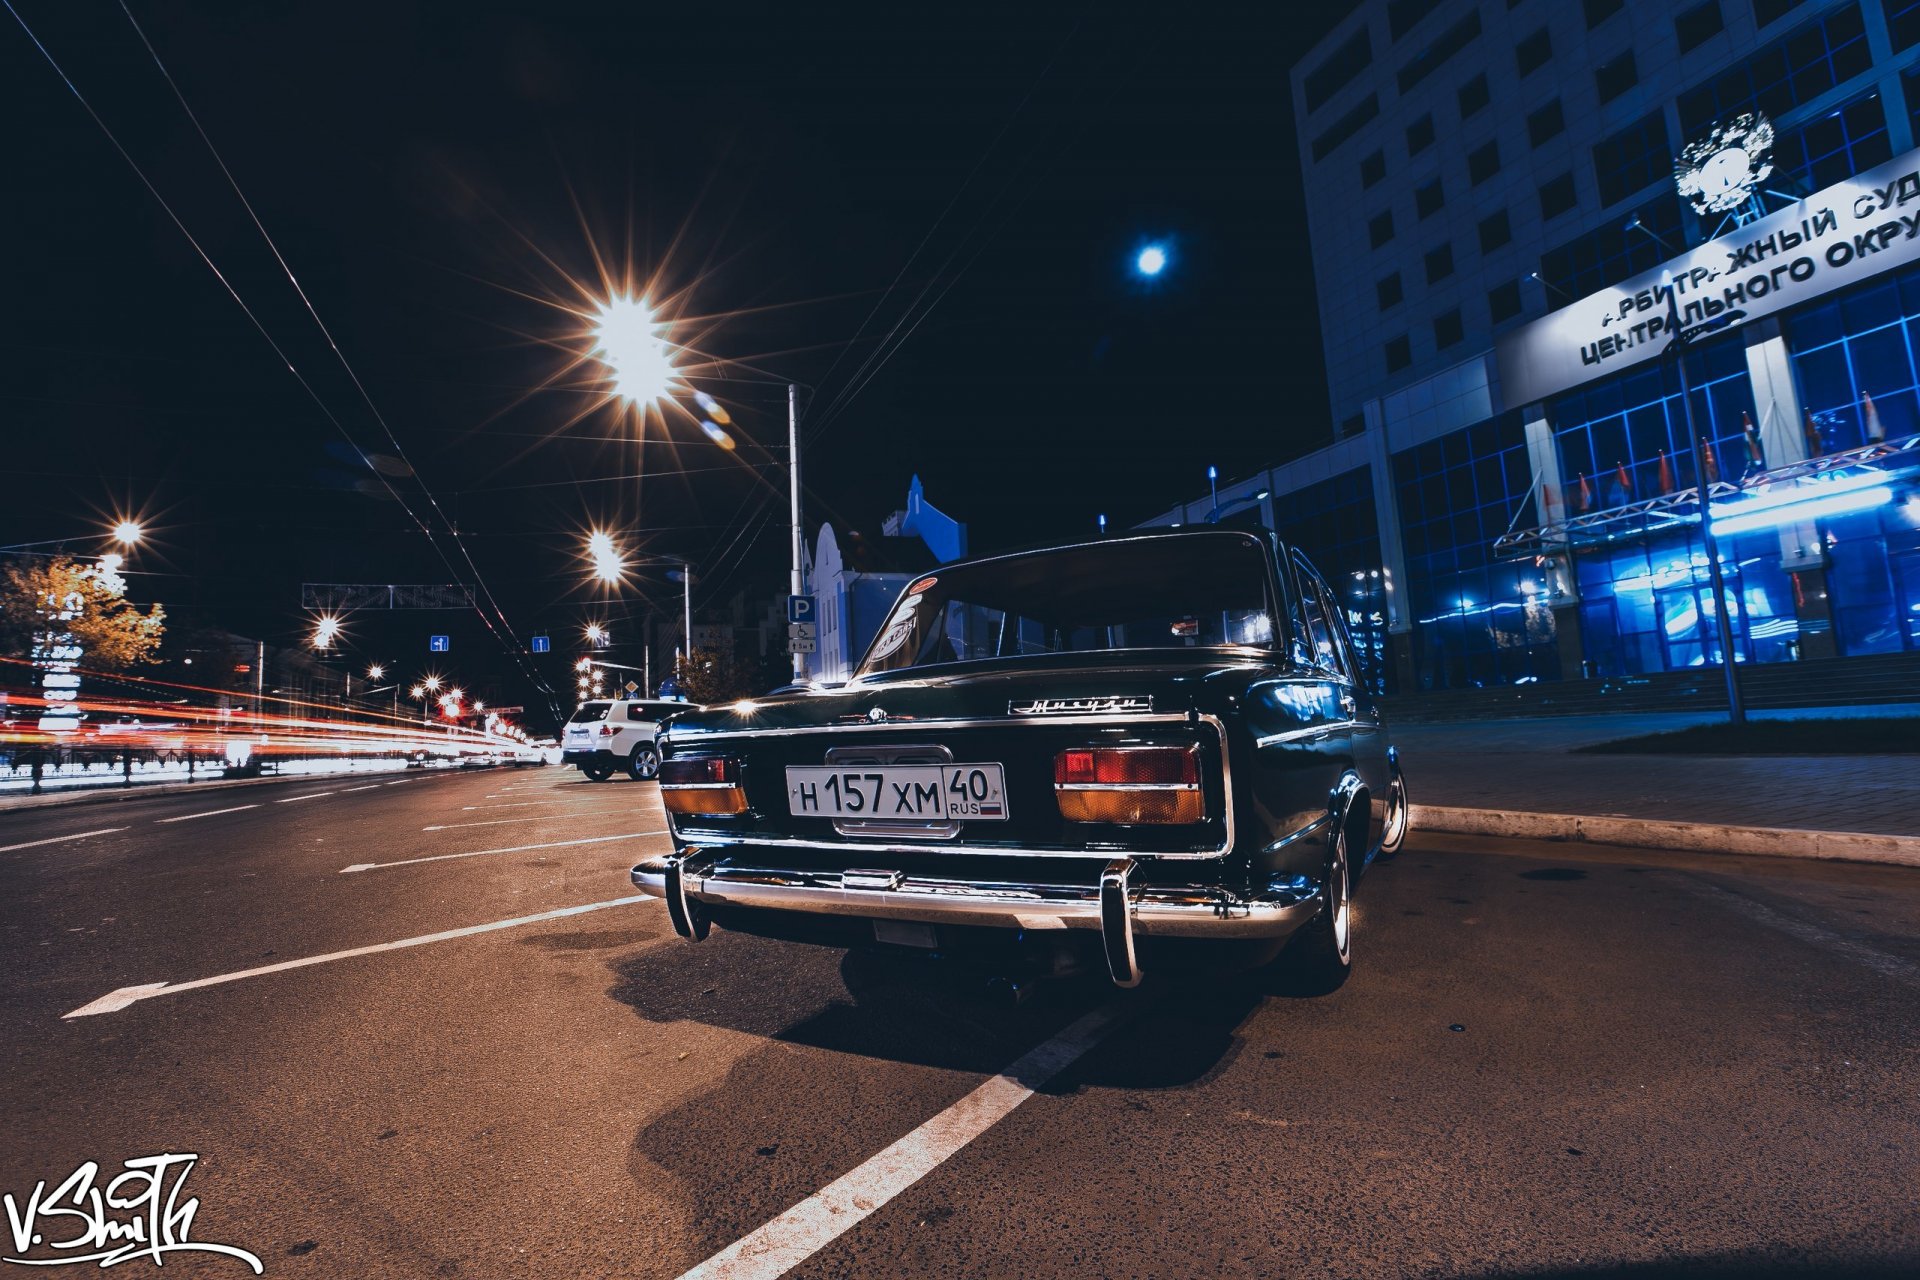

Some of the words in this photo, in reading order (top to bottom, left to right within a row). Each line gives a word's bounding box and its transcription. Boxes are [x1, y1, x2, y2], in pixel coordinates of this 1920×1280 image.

[1601, 207, 1838, 327] РБИТРЖНЫЙ
[1853, 171, 1920, 219] СУД
[950, 769, 989, 801] 40
[950, 802, 979, 815] RUS
